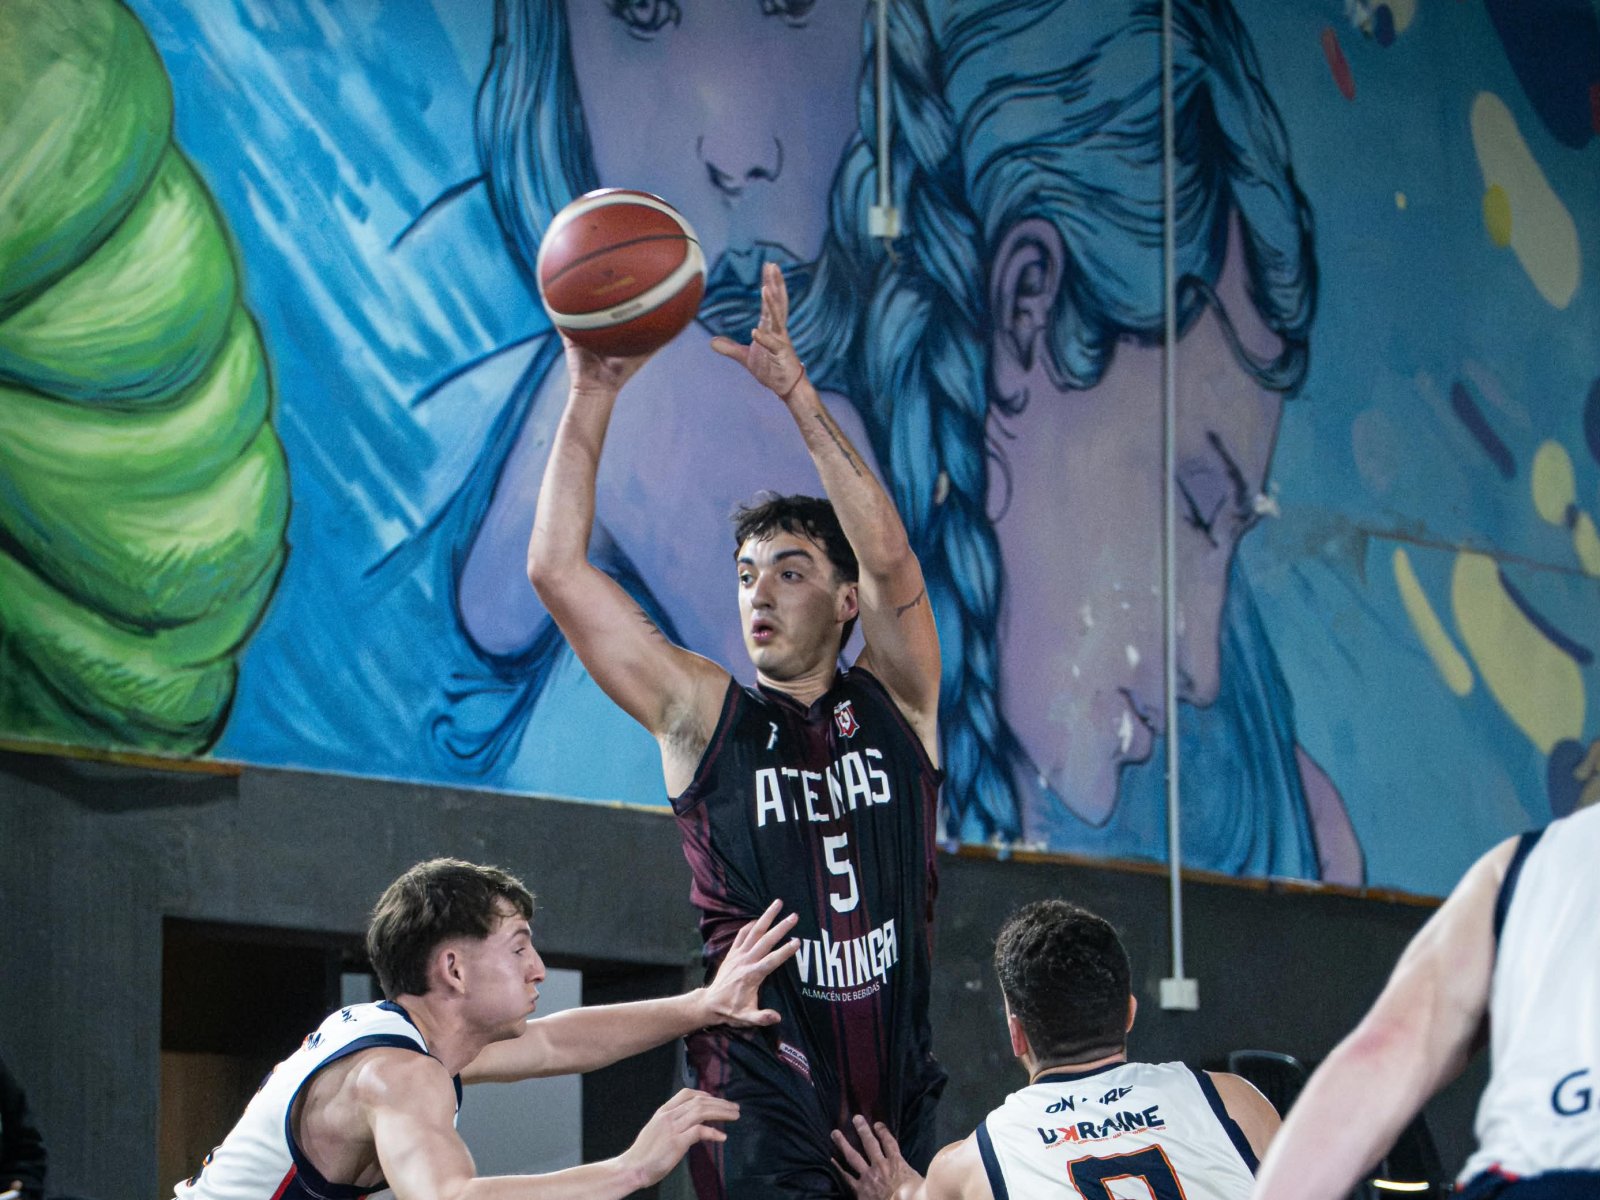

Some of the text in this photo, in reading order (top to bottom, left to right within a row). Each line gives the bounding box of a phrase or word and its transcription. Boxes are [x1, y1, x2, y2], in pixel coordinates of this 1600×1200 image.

[756, 748, 891, 827] ATENAS
[822, 832, 860, 913] 5
[802, 981, 880, 1002] ALMACÉN DE BEBIDAS
